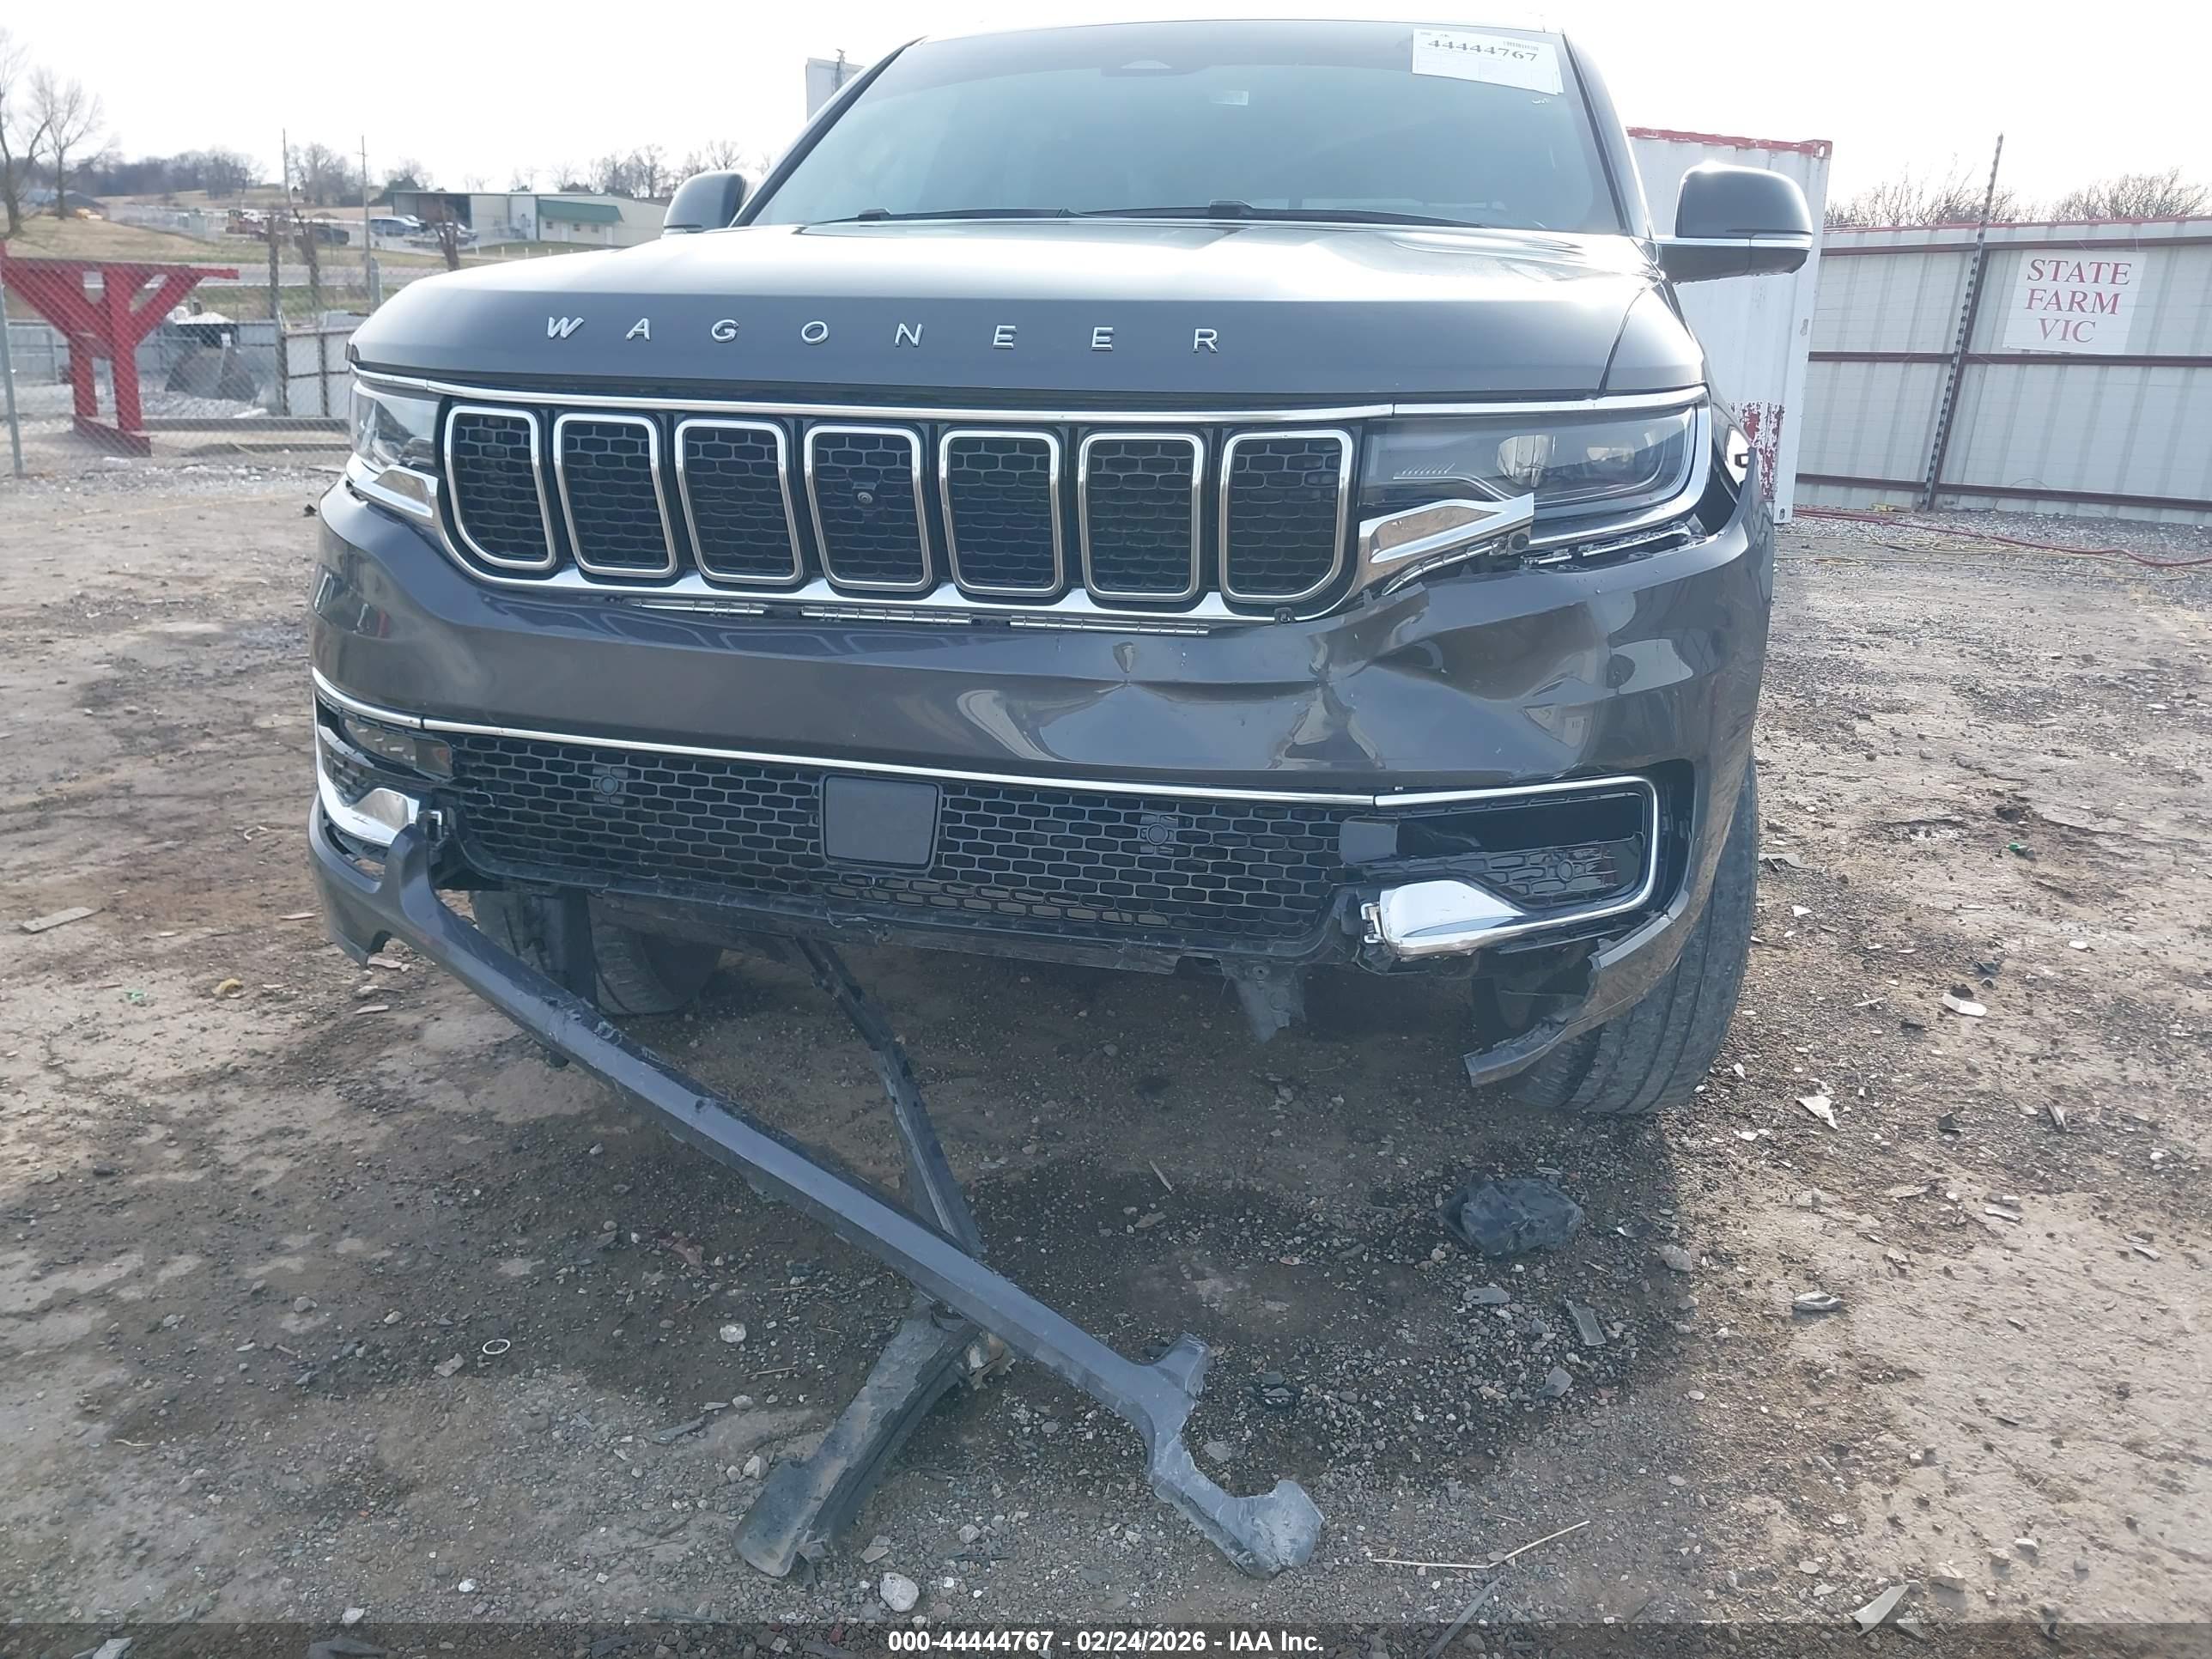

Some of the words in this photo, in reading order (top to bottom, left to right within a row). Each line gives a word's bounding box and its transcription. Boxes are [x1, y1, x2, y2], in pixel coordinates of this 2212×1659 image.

[1428, 40, 1538, 62] 44444767
[2027, 258, 2132, 286] STATE
[2024, 288, 2122, 315] FARM
[545, 314, 1220, 354] WAGONEER
[2039, 318, 2096, 343] VIC
